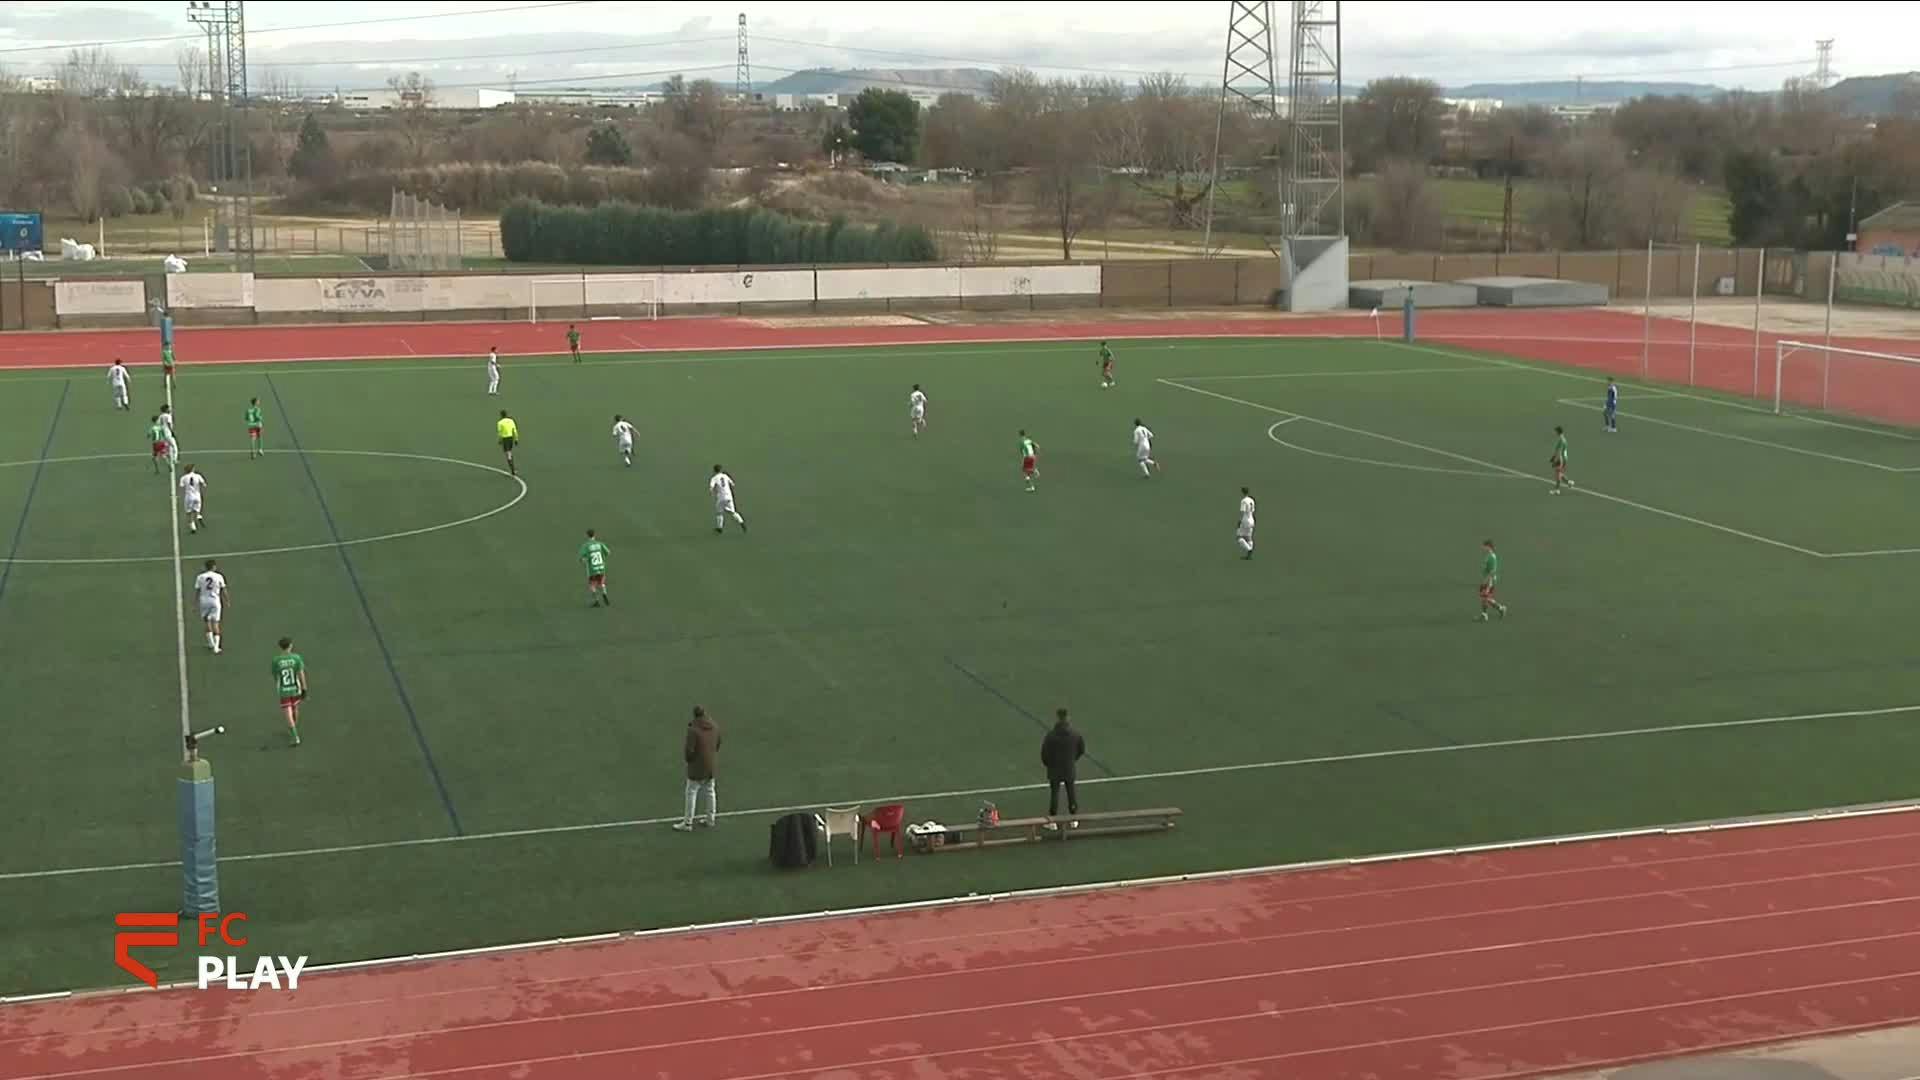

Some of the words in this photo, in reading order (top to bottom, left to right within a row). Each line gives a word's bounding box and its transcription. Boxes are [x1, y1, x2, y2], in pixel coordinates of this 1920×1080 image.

[324, 289, 384, 298] LEYVA
[590, 551, 603, 566] 20
[205, 577, 213, 591] 2
[281, 668, 295, 686] 21
